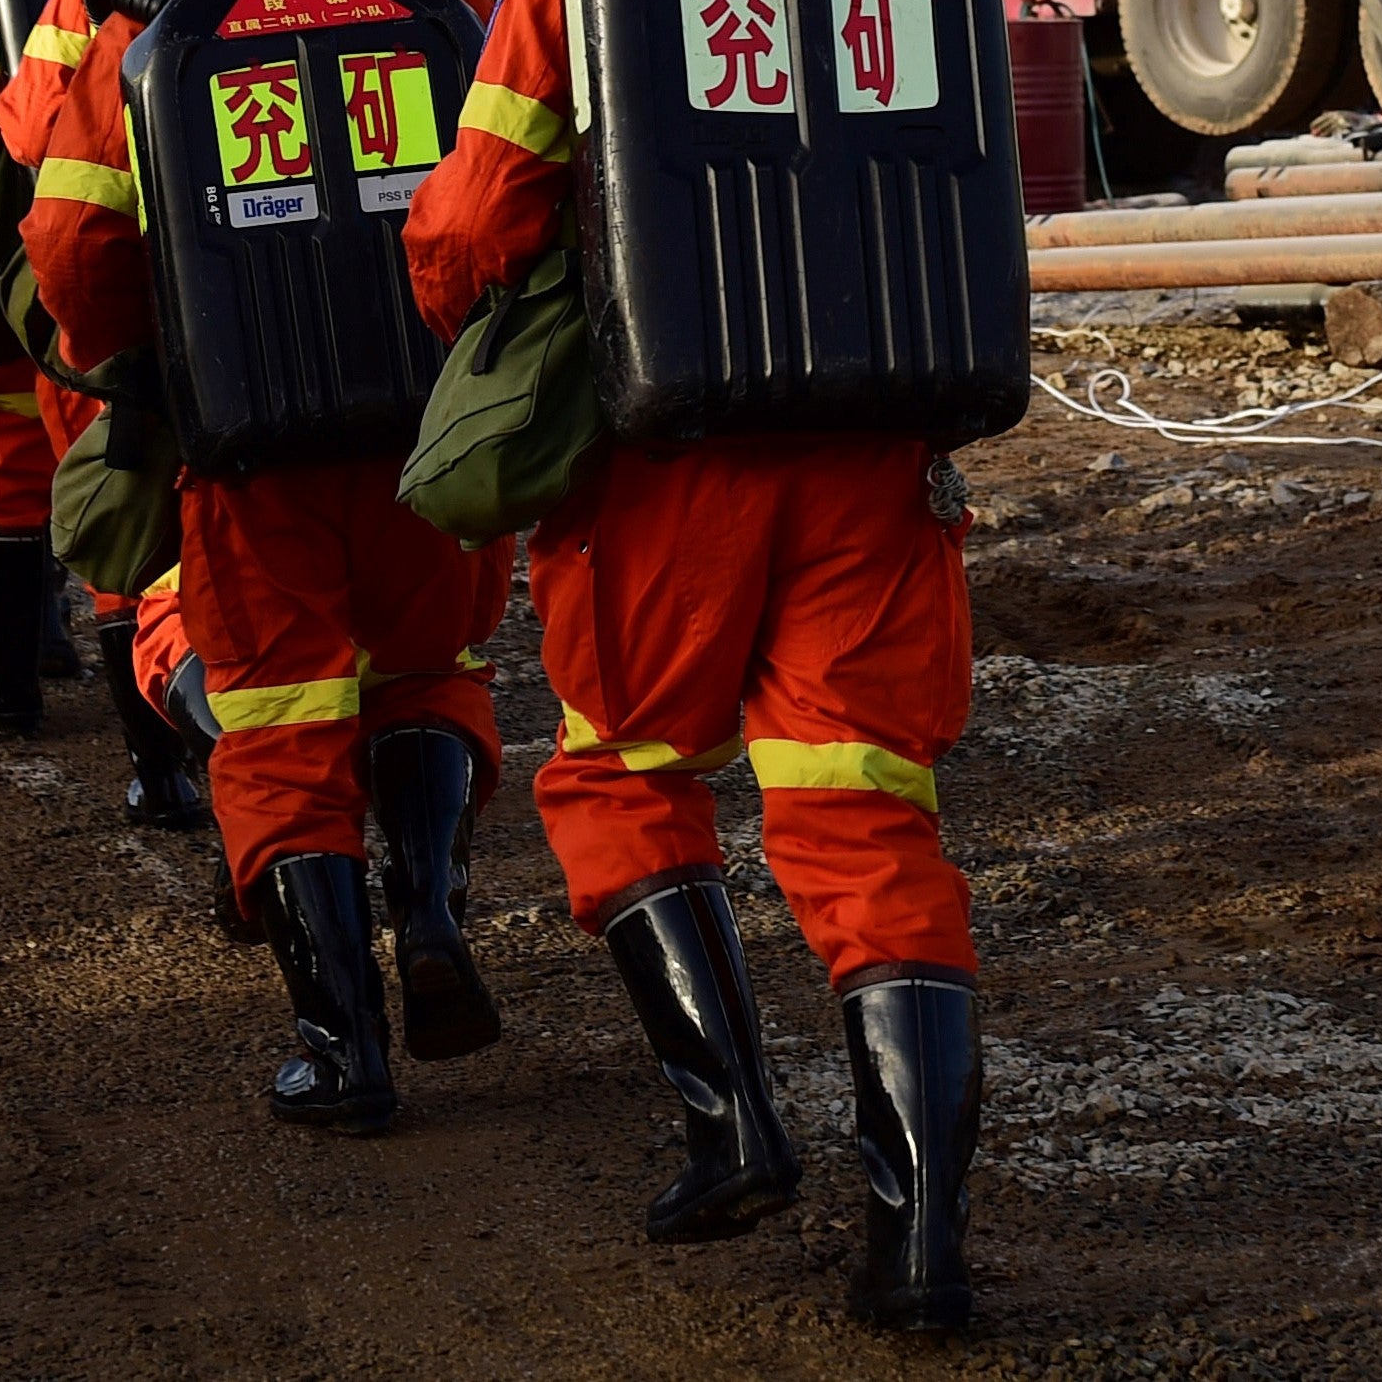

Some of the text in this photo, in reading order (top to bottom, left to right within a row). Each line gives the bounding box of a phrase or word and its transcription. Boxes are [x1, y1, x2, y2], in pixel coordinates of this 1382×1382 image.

[205, 186, 218, 203] BG
[378, 189, 416, 203] PSS B
[242, 195, 305, 219] Dräger
